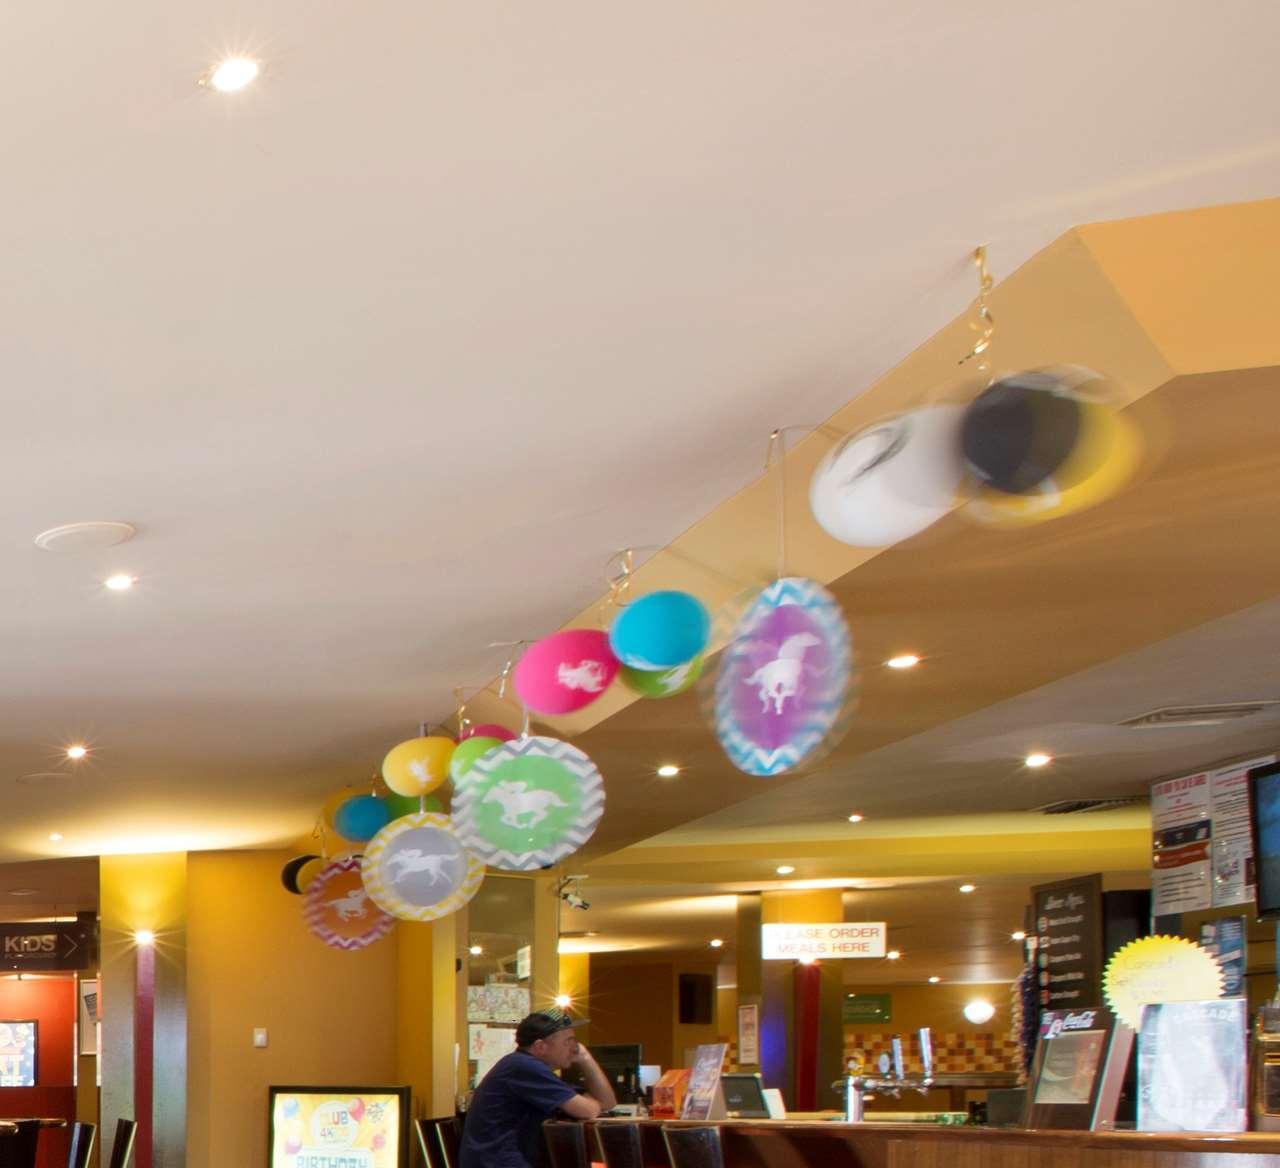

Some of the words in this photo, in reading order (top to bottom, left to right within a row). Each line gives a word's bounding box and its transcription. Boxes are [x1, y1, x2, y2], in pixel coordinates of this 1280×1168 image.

[768, 928, 824, 939] LEASE
[829, 928, 880, 939] ORDER
[4, 934, 58, 952] KIDS
[776, 942, 826, 953] MEALS
[831, 942, 871, 953] HERE
